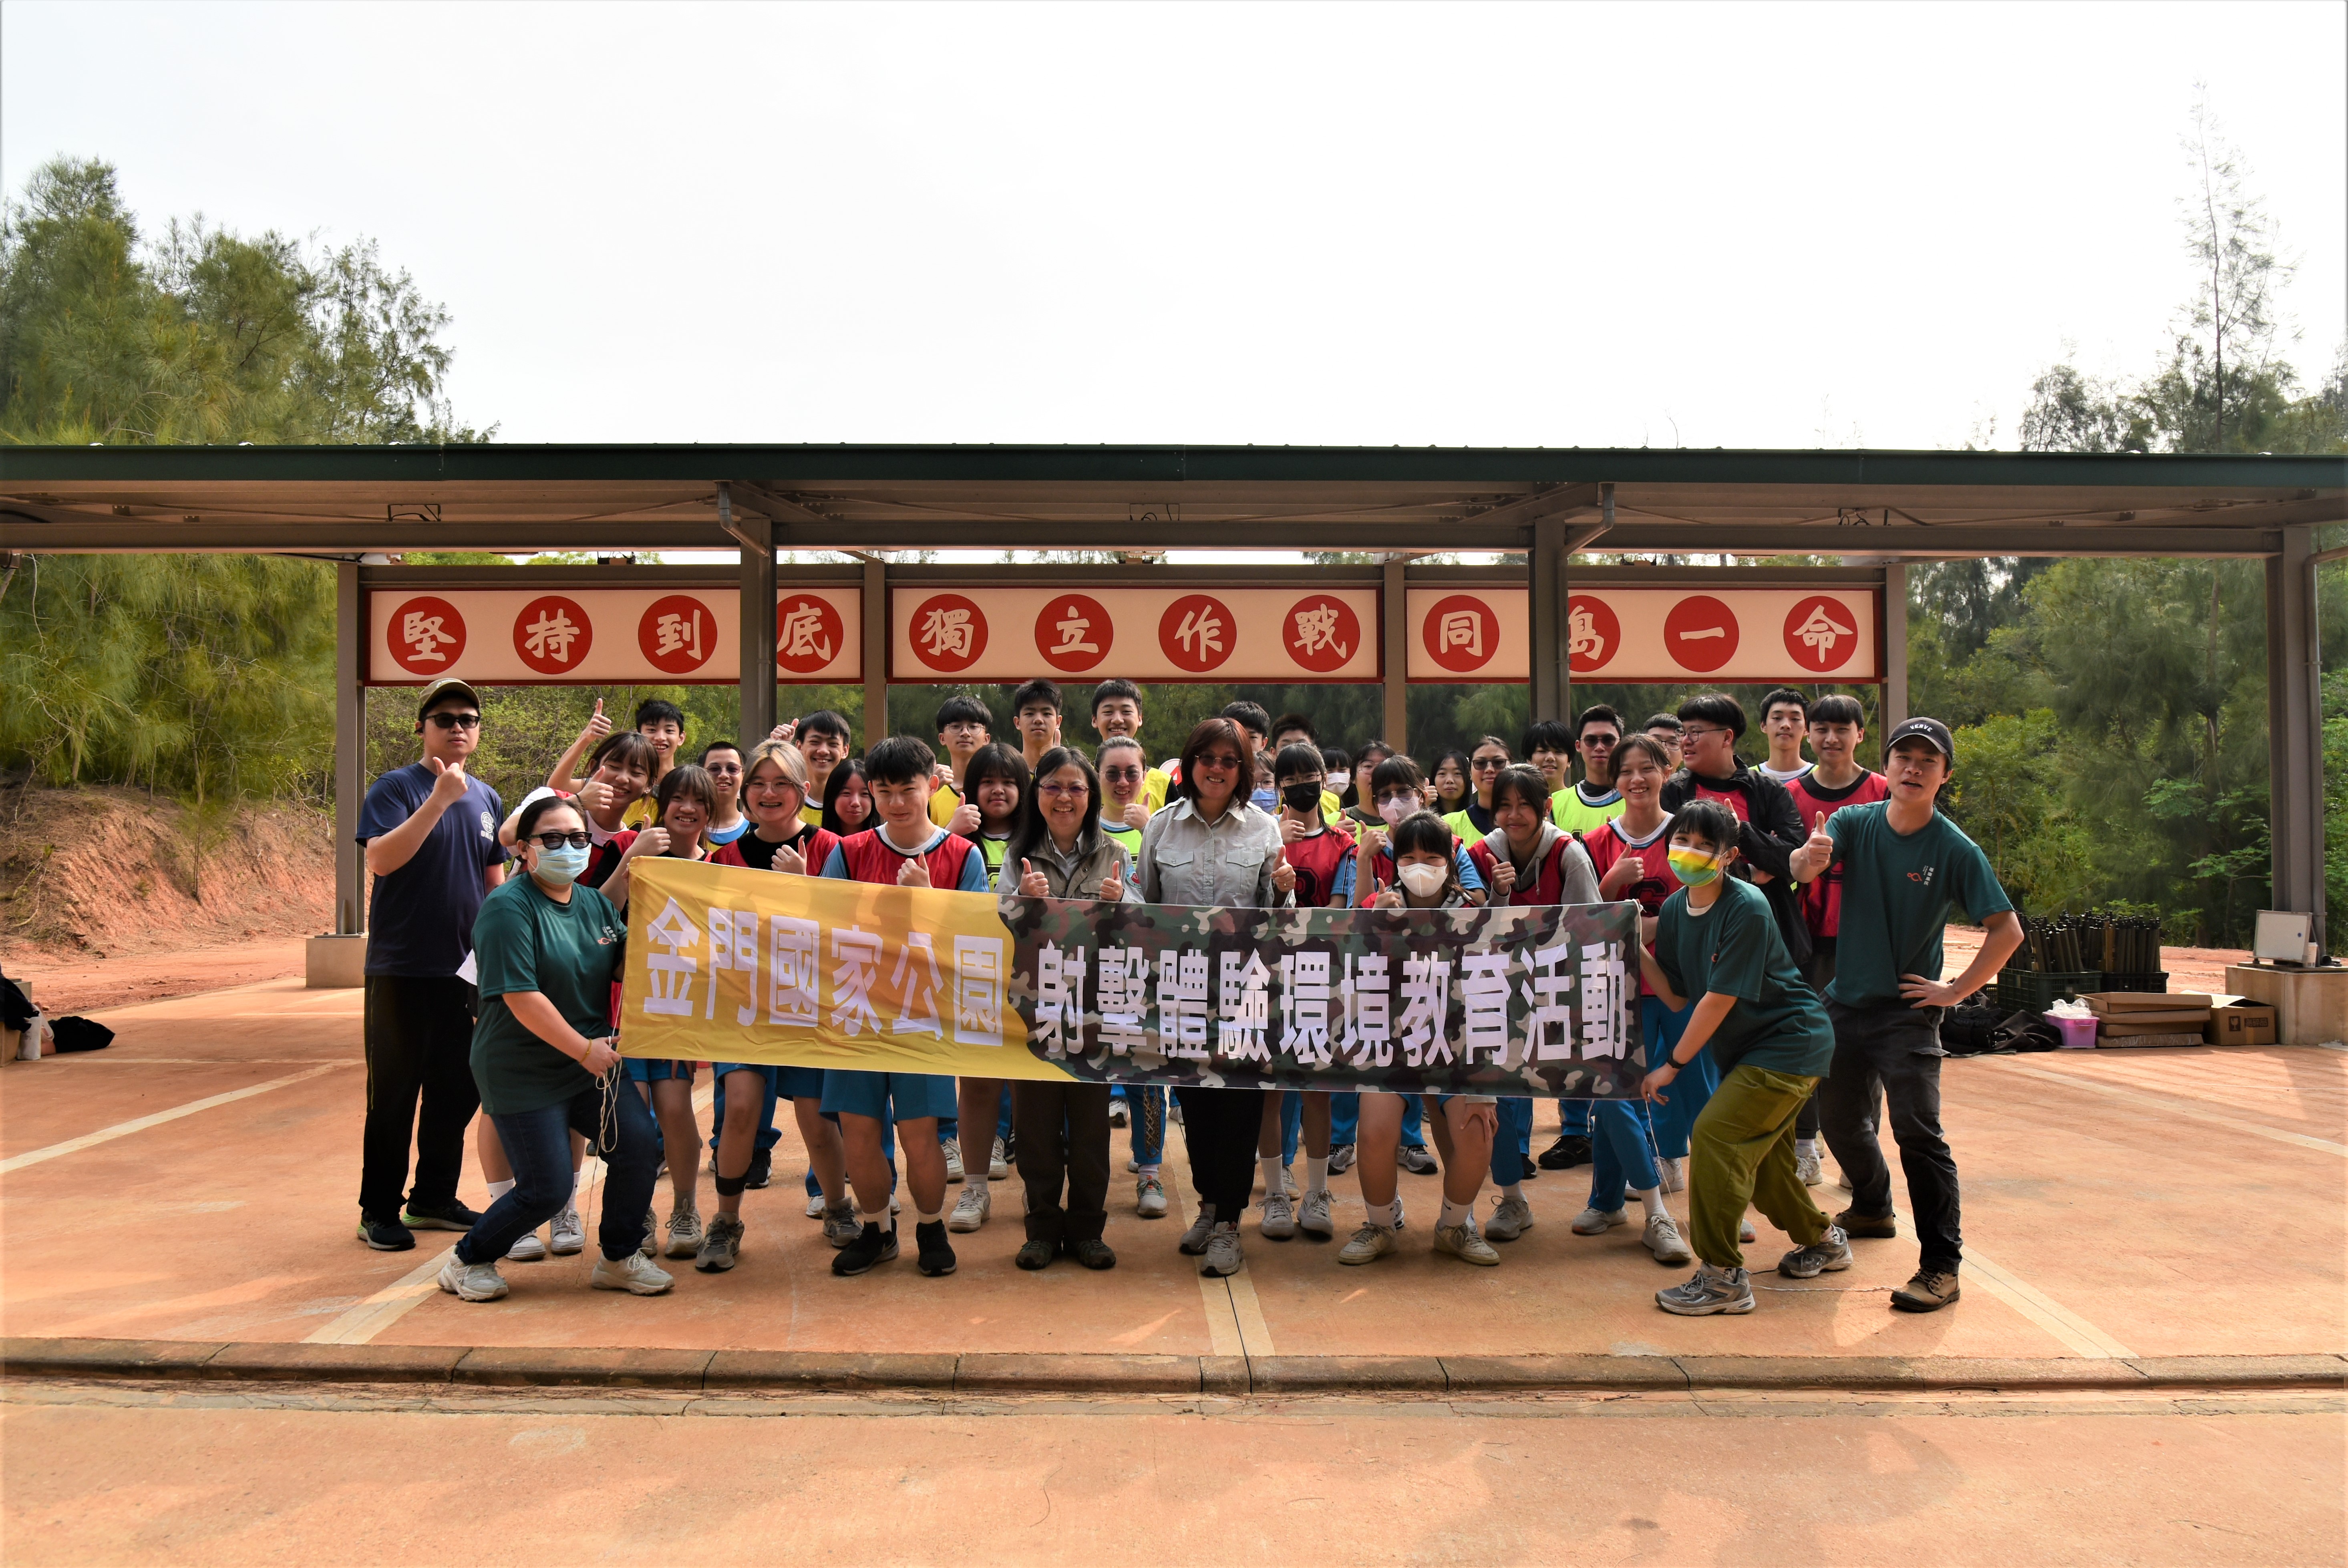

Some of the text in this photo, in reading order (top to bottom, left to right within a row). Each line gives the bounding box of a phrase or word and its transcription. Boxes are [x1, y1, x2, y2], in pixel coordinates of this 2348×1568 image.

[403, 602, 831, 663] 堅持到底
[920, 603, 1347, 662] 獨立作戰
[1909, 724, 1933, 732] VERVE
[643, 896, 1627, 1067] 金門國家公園 射擊體驗環境教育活動
